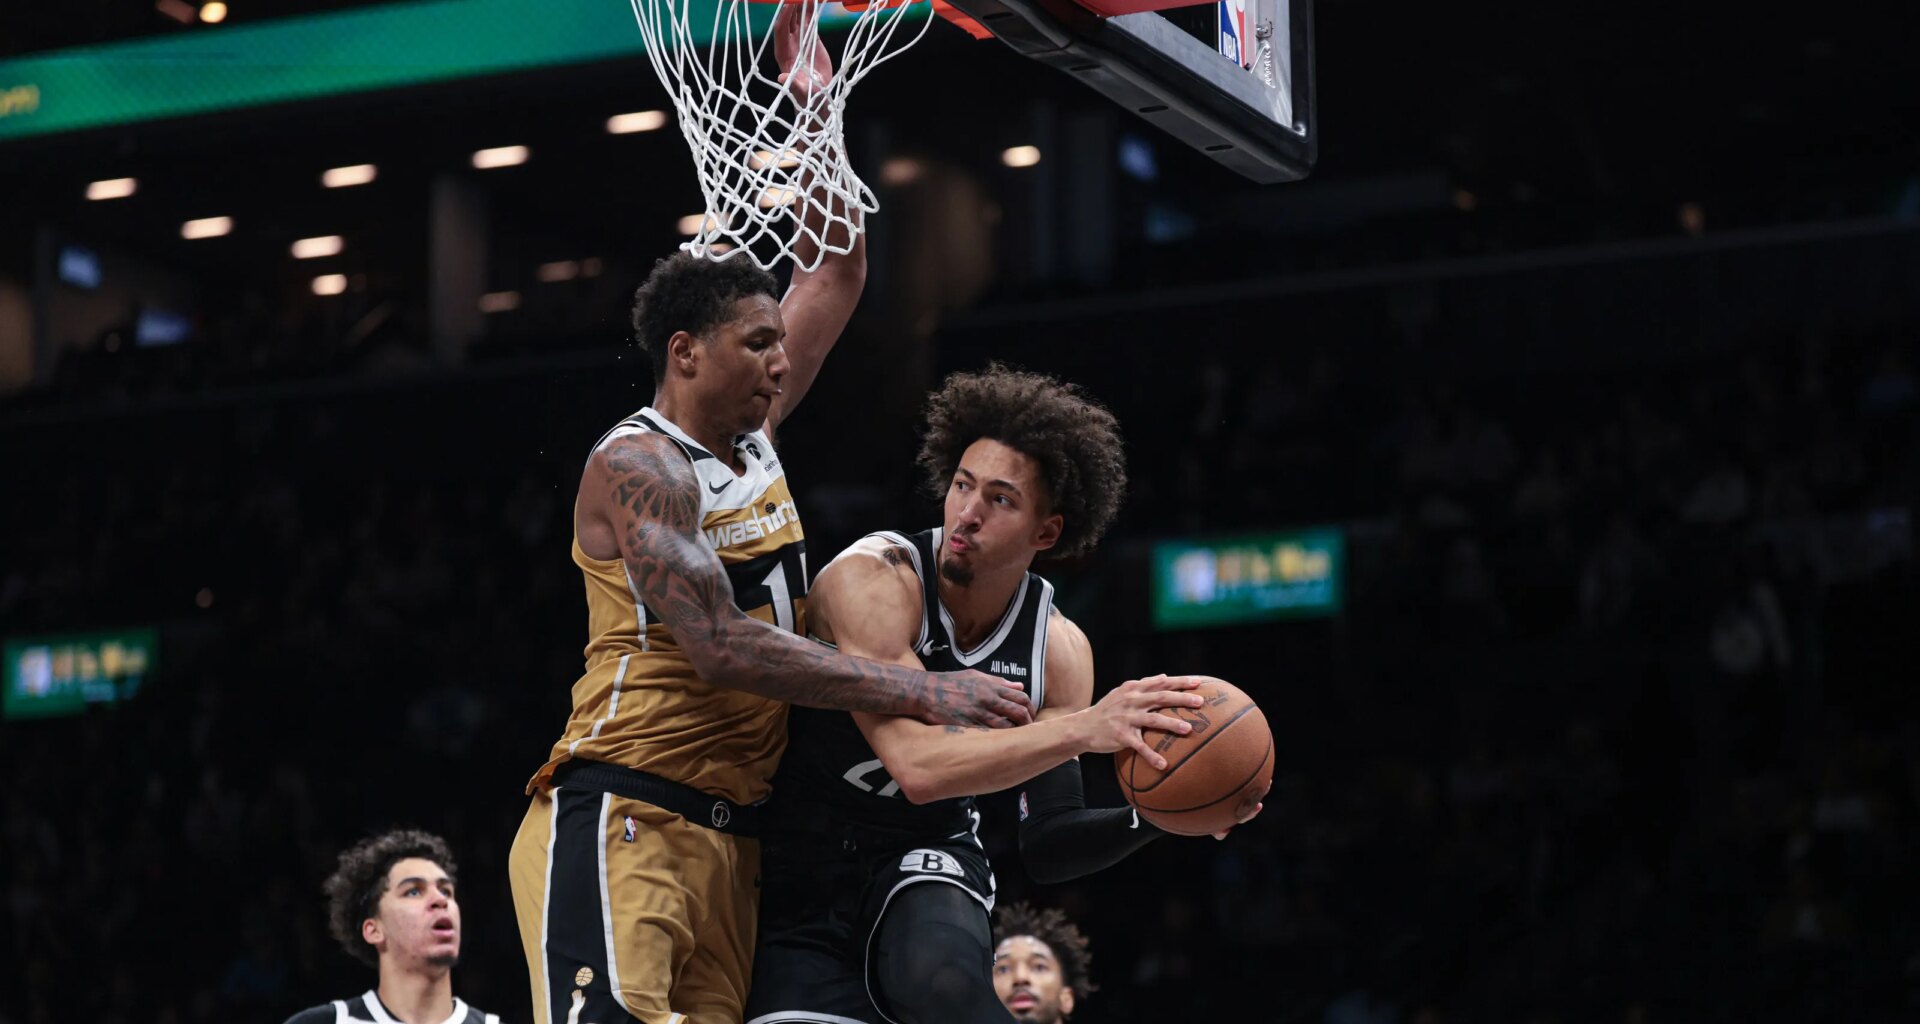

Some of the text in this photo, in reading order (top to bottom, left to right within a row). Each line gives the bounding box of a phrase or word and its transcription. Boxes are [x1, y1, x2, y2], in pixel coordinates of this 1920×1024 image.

[1223, 31, 1237, 62] NBA
[991, 660, 1027, 677] All In Won
[921, 853, 944, 872] B
